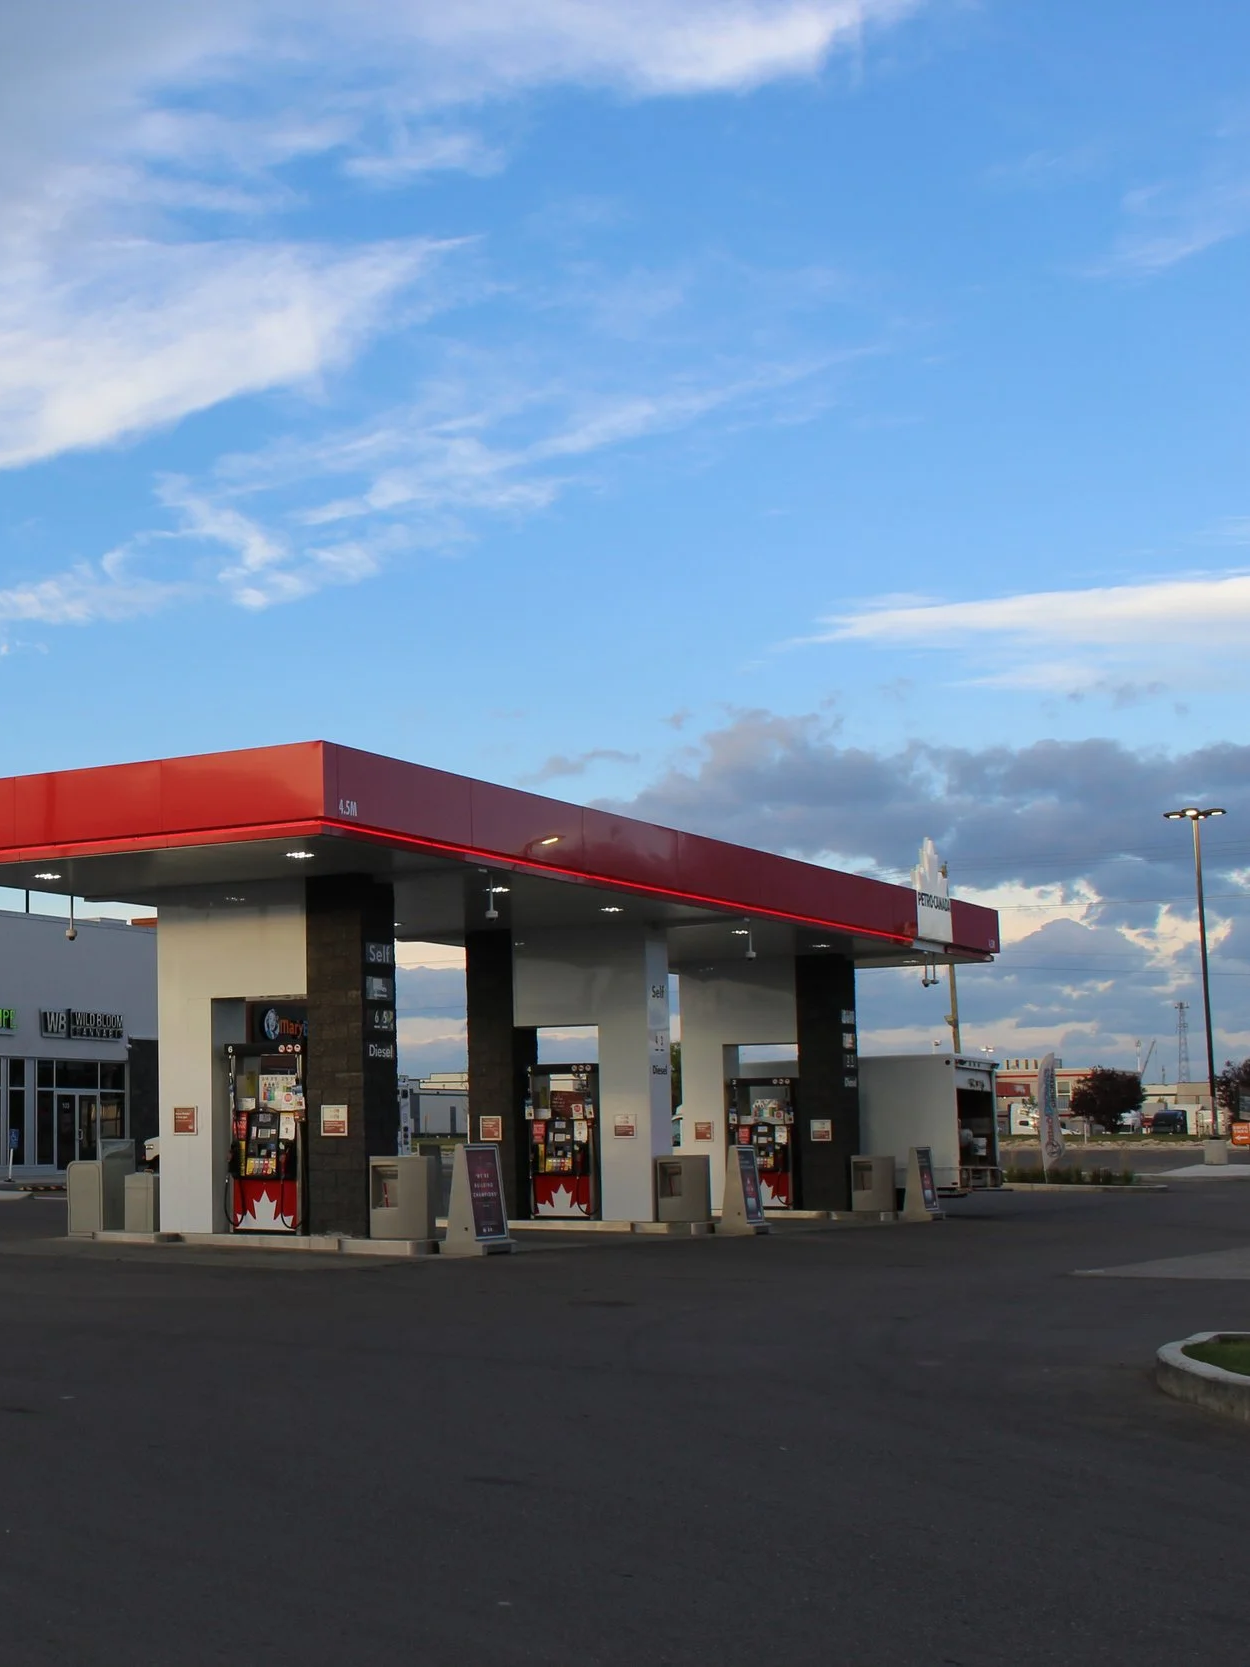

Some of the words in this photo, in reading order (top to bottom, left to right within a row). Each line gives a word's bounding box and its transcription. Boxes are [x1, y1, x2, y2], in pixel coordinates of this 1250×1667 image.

[917, 892, 950, 912] PETRO-CANADA
[368, 944, 391, 963] Self
[652, 985, 665, 999] Self
[46, 1011, 67, 1034] WB
[75, 1012, 95, 1027] WILD
[96, 1013, 123, 1029] BLOOM
[368, 1043, 393, 1058] Diesel
[652, 1064, 668, 1075] Diesel
